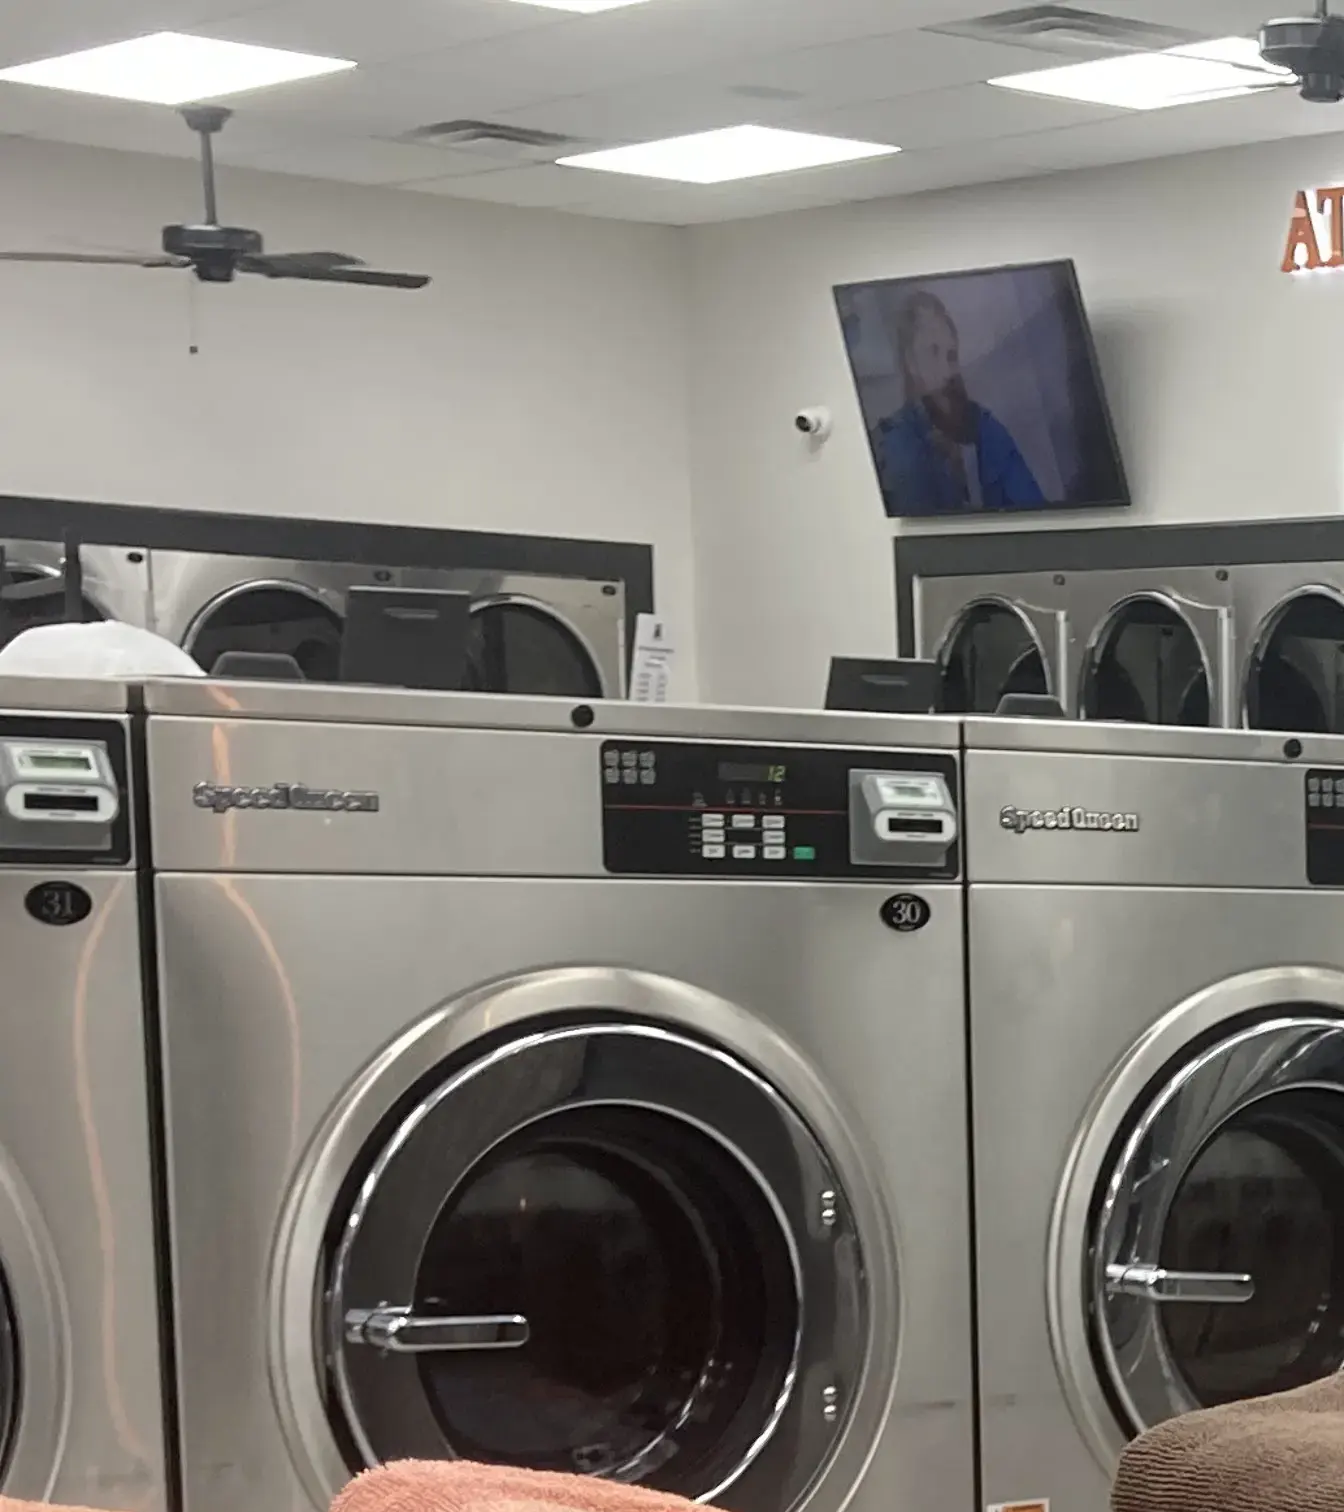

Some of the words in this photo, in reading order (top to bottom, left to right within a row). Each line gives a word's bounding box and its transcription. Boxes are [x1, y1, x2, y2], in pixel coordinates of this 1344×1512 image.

[1000, 804, 1070, 833] Speed
[1071, 804, 1139, 832] Queen
[893, 901, 920, 924] 30
